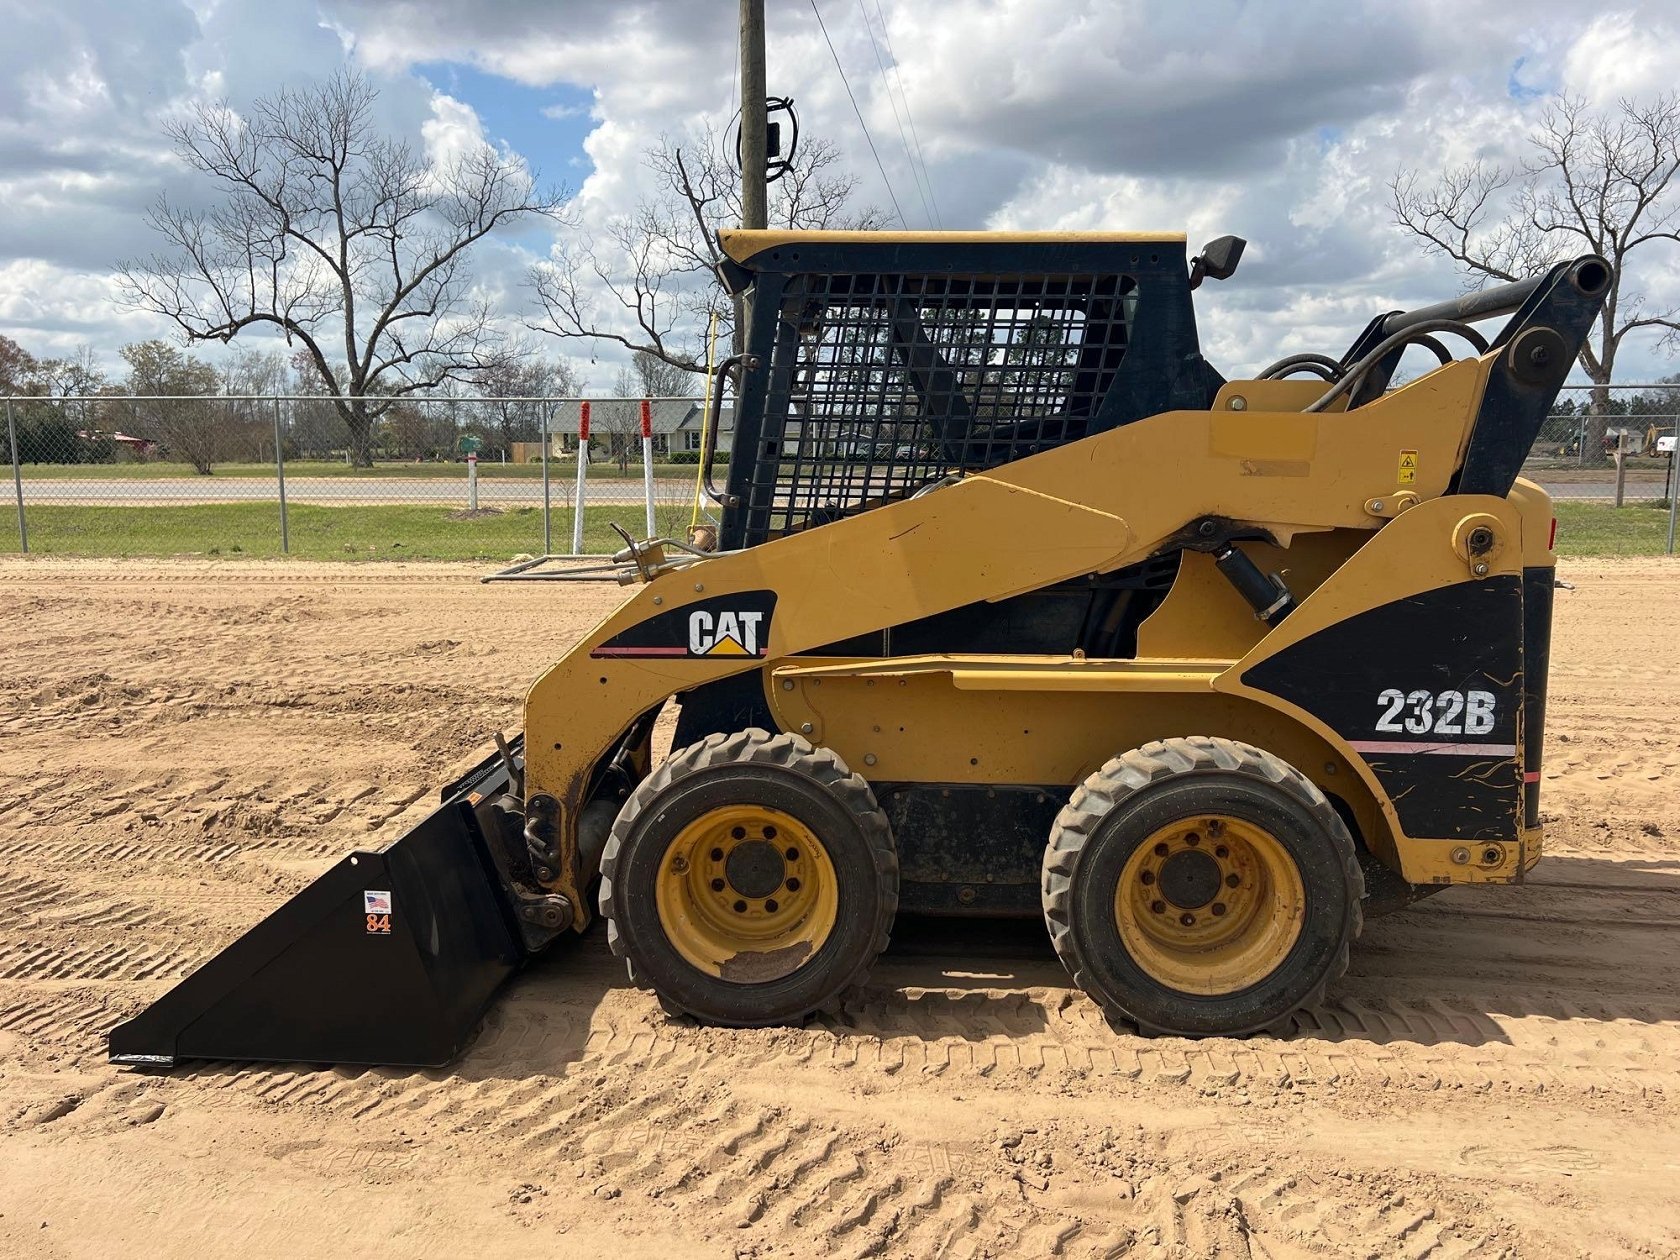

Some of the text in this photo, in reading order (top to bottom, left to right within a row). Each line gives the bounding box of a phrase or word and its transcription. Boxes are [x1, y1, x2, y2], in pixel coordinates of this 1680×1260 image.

[689, 611, 762, 655] CAT
[1375, 688, 1496, 735] 232B
[366, 914, 391, 932] 84
